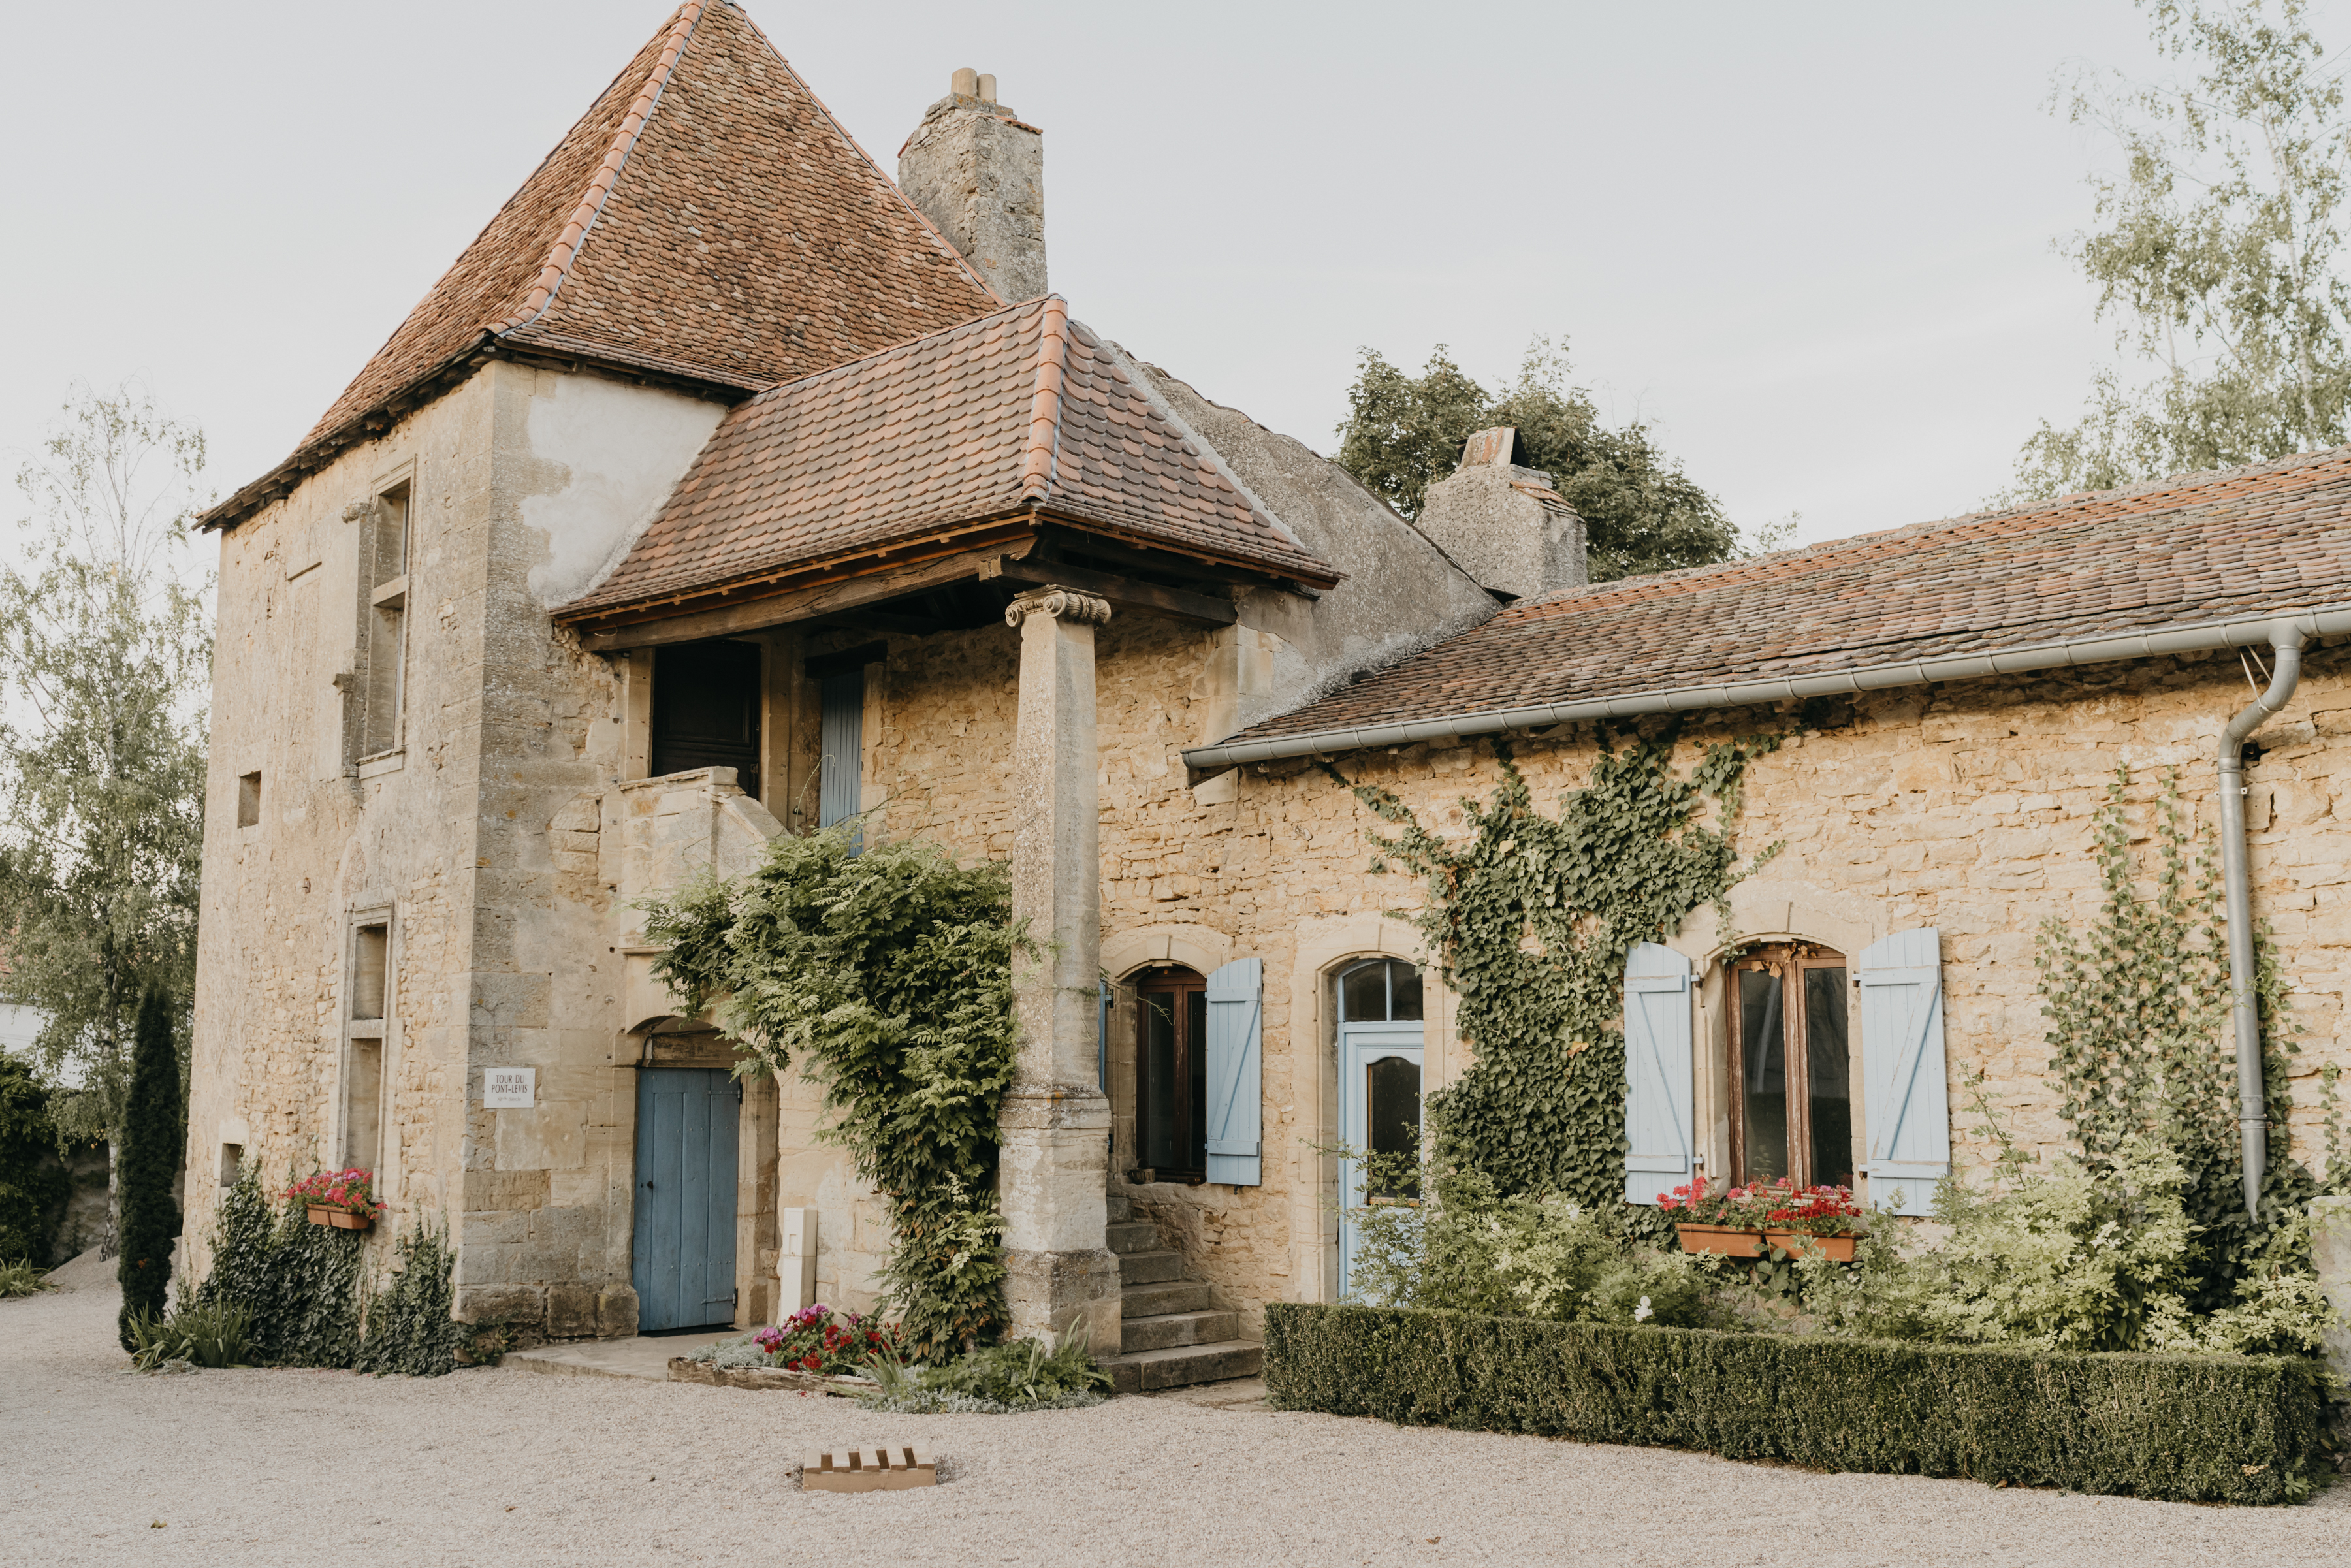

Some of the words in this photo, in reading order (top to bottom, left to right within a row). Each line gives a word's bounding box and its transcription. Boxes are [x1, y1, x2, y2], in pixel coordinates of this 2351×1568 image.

[496, 1074, 513, 1084] TOUR
[515, 1074, 525, 1084] DU
[491, 1084, 528, 1093] PONT-LEVIS
